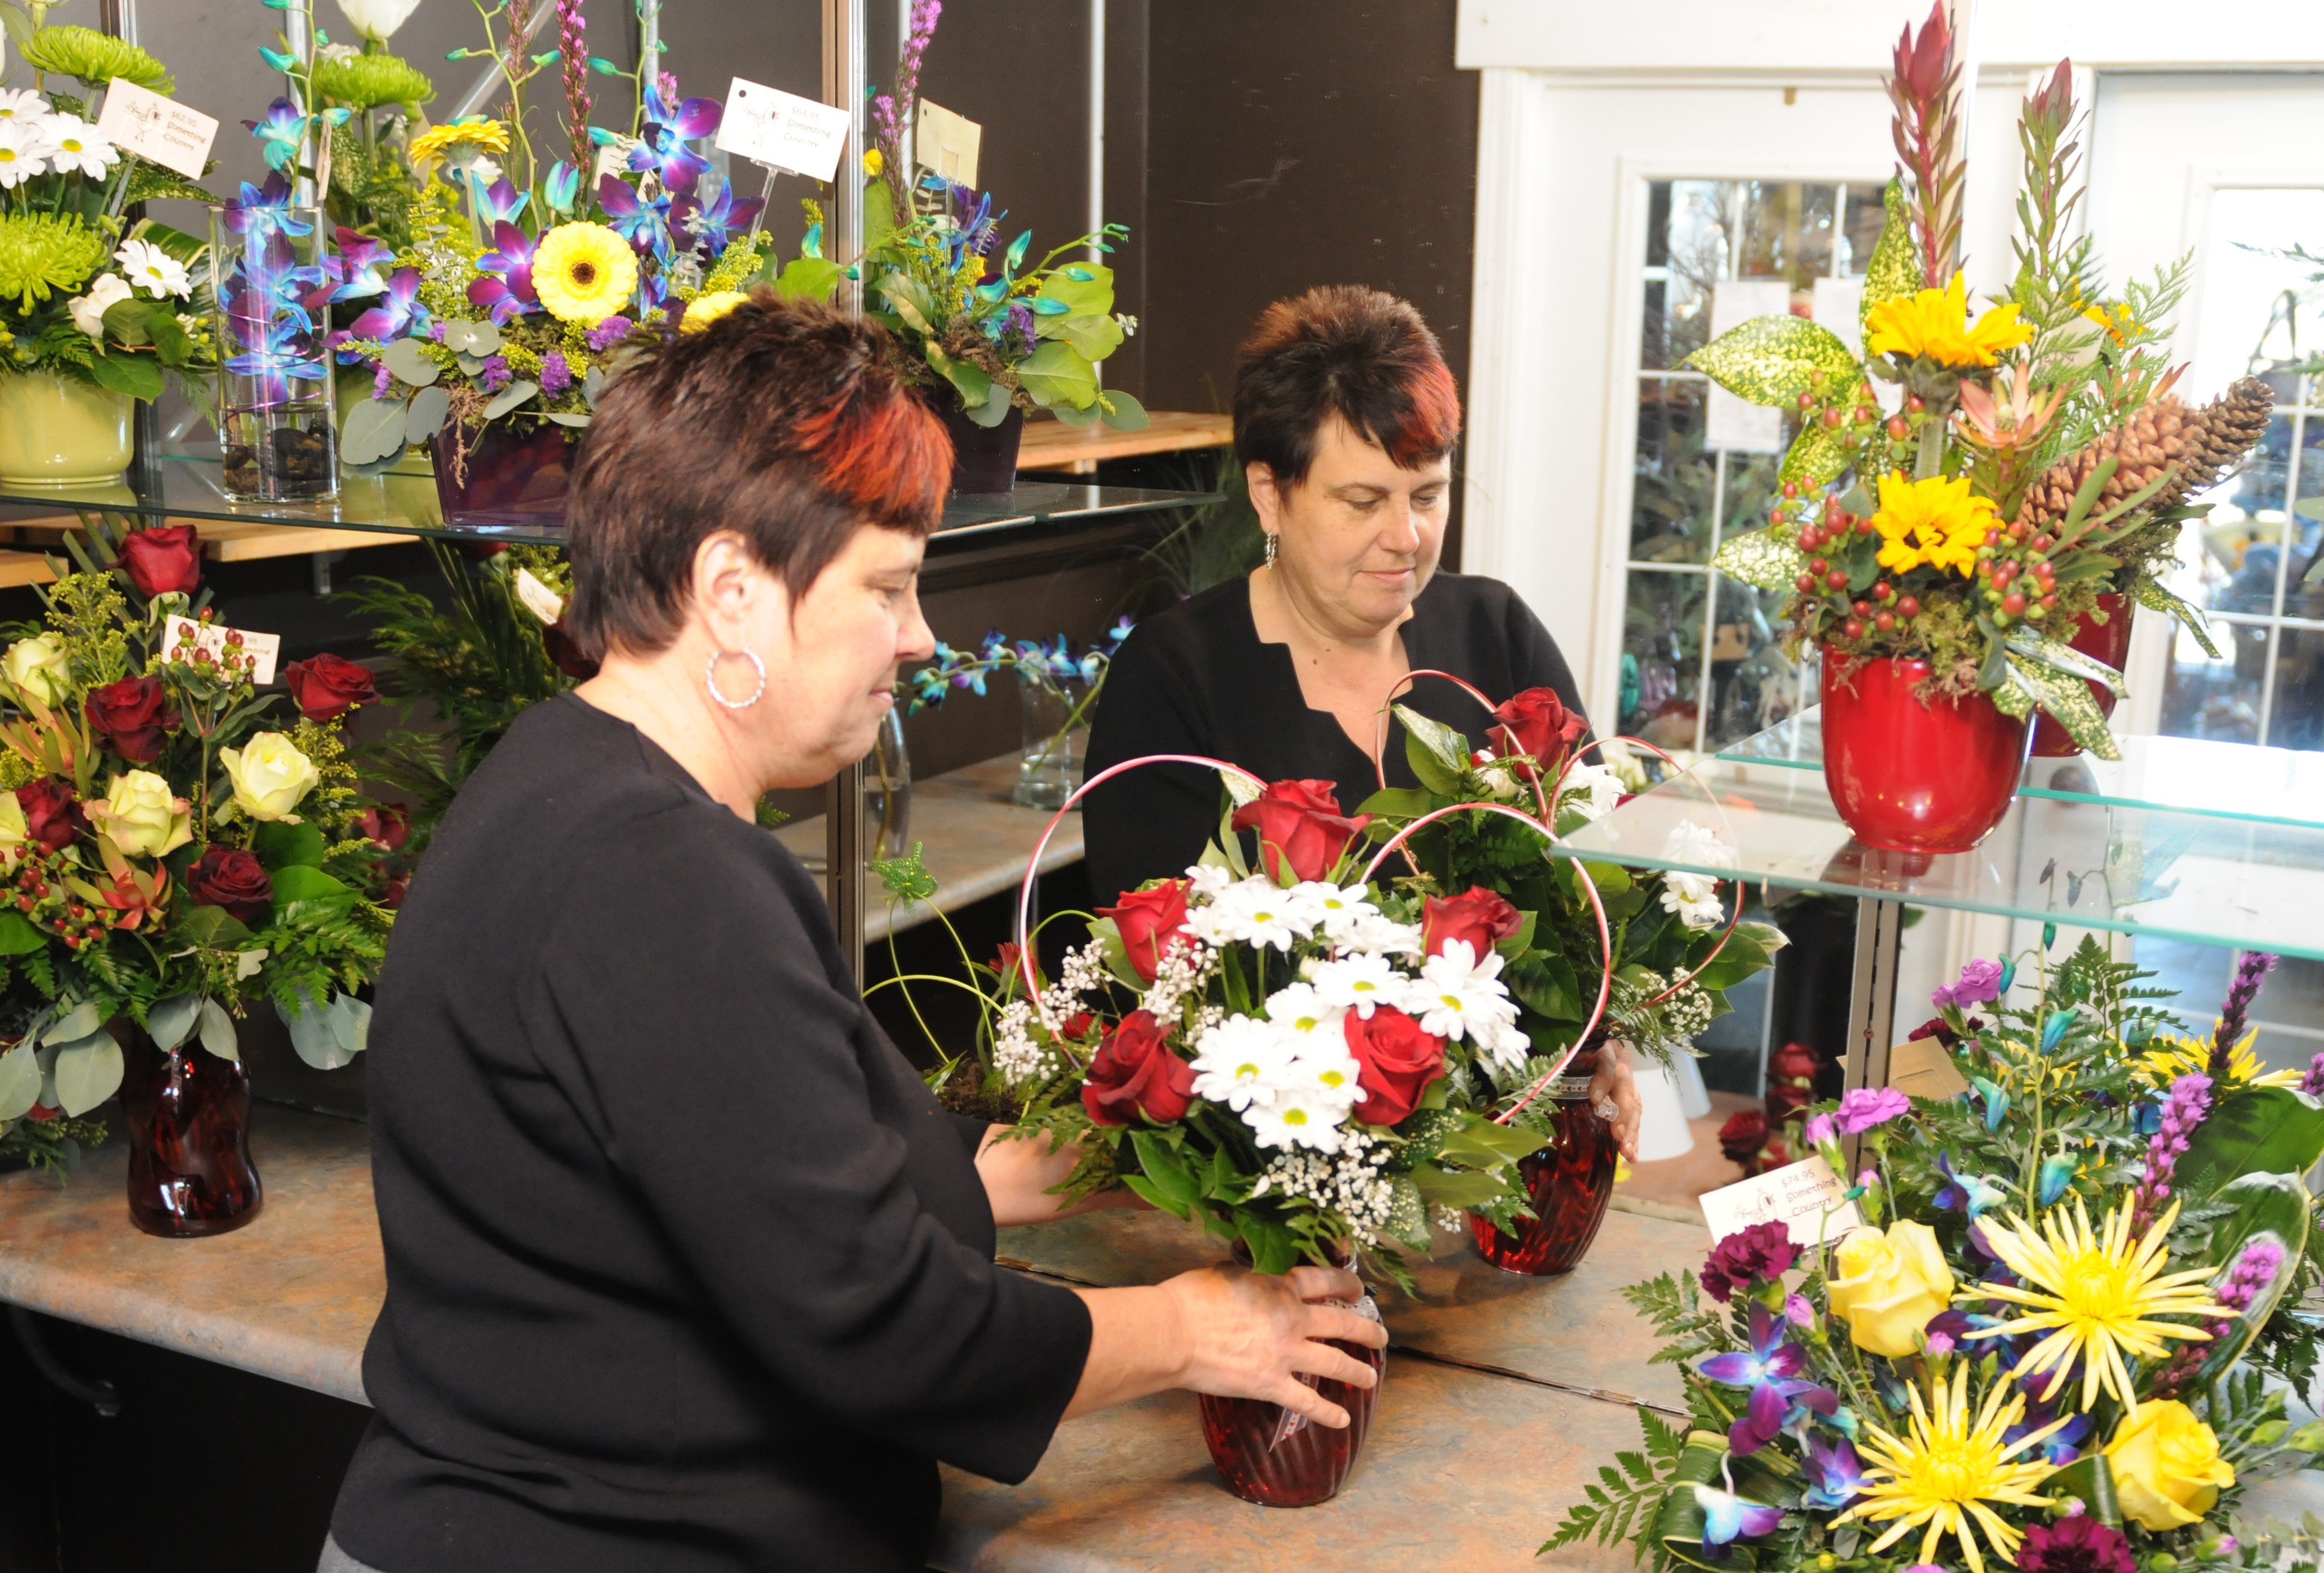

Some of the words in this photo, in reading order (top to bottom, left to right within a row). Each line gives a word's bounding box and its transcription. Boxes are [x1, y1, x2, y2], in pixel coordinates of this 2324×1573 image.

[167, 122, 206, 144] Something
[787, 119, 832, 139] Something
[1781, 1169, 1816, 1188] $74.95
[1786, 1177, 1837, 1203] Something
[1792, 1196, 1832, 1217] Country
